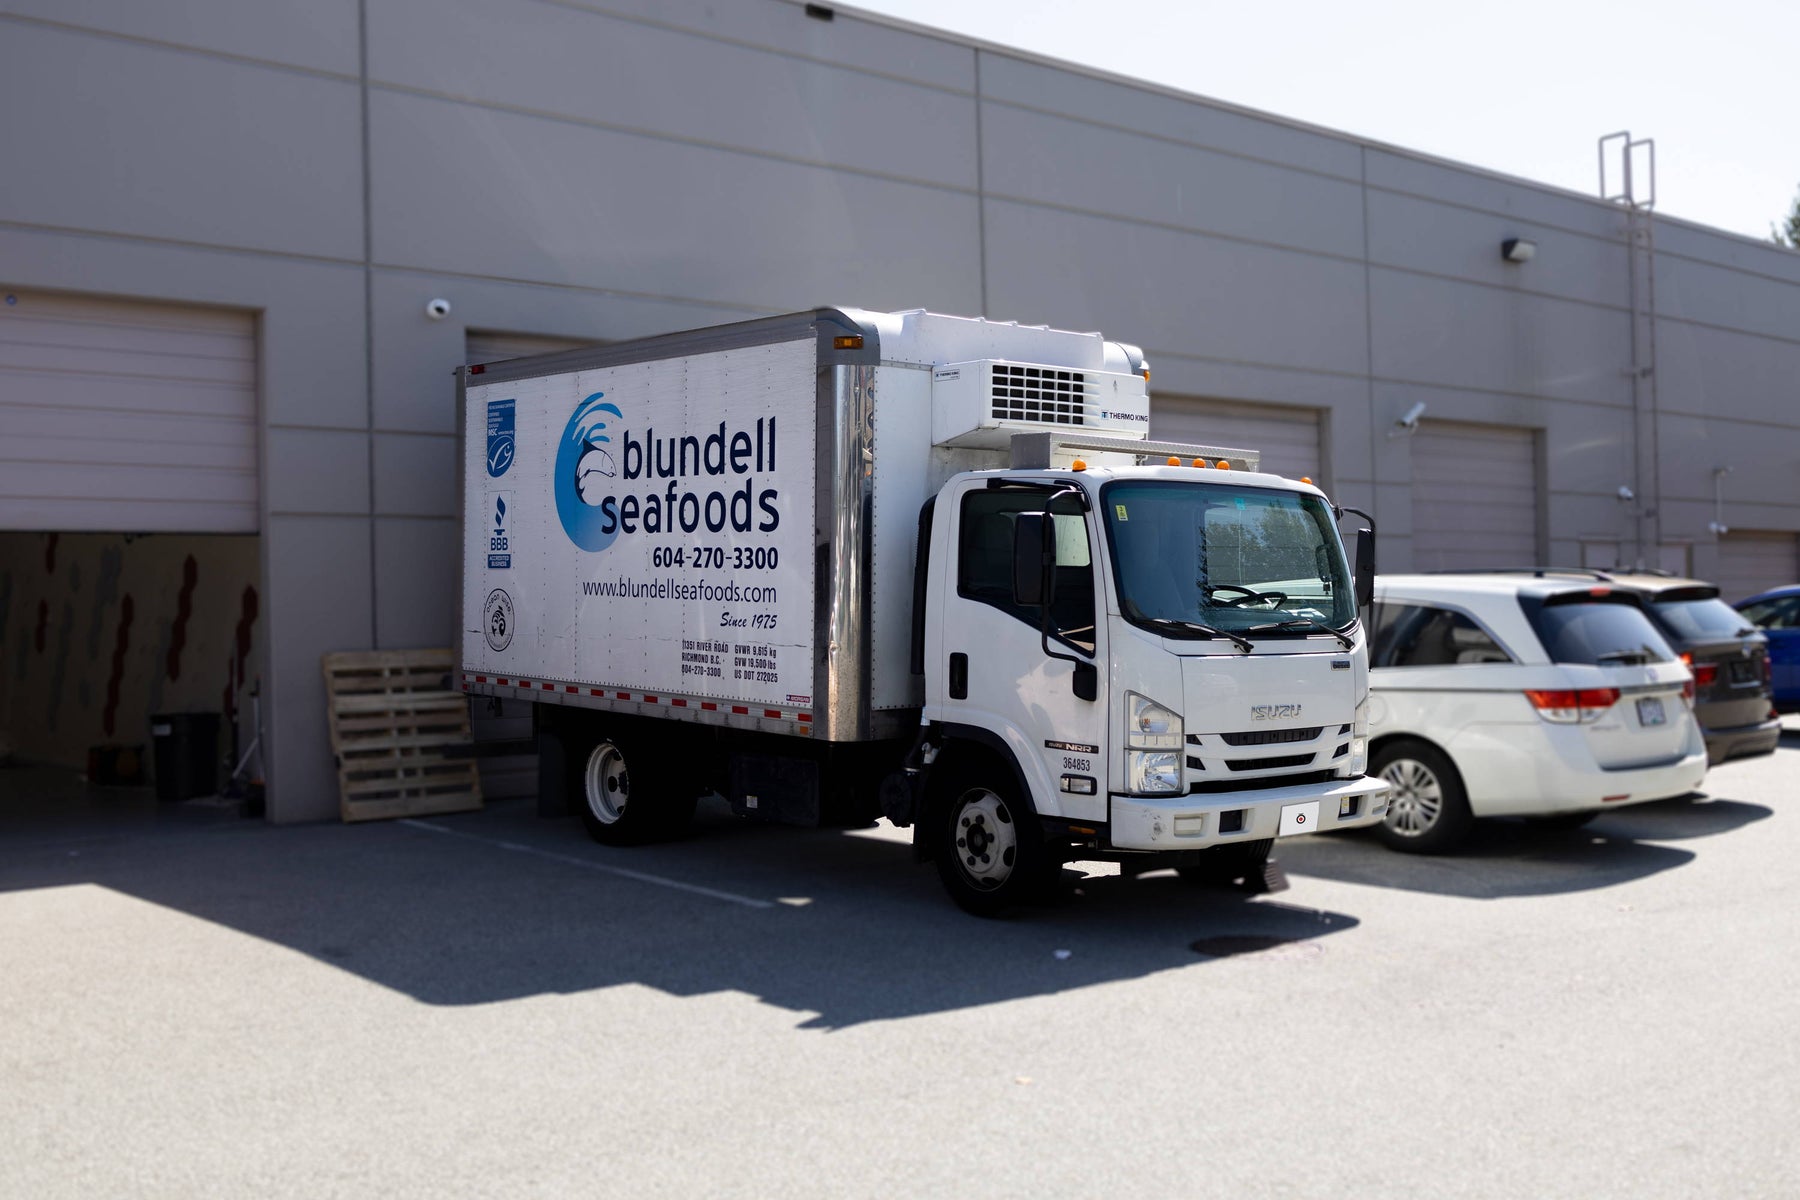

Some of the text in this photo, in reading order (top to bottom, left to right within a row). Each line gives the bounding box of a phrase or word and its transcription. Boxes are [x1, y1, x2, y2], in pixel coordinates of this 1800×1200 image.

[1109, 412, 1135, 421] THERMO
[623, 416, 776, 480] blundell
[601, 477, 780, 535] seafoods
[490, 537, 509, 551] BBB
[653, 547, 779, 569] 604-270-3300
[583, 577, 777, 603] www.blundellseafoods.com
[720, 612, 778, 629] Since 1975
[682, 640, 729, 653] 11351 RIVER ROAD
[734, 644, 777, 659] GVWR 9,615 kg
[681, 652, 721, 664] RICHMOND B.C.
[734, 657, 776, 670] GVW 19,500 lbs
[681, 664, 721, 677] 604-270-3300
[734, 670, 779, 683] US DOT 272025
[1251, 704, 1302, 720] ISUZU
[1065, 743, 1092, 752] NRR
[1063, 757, 1091, 771] 364853
